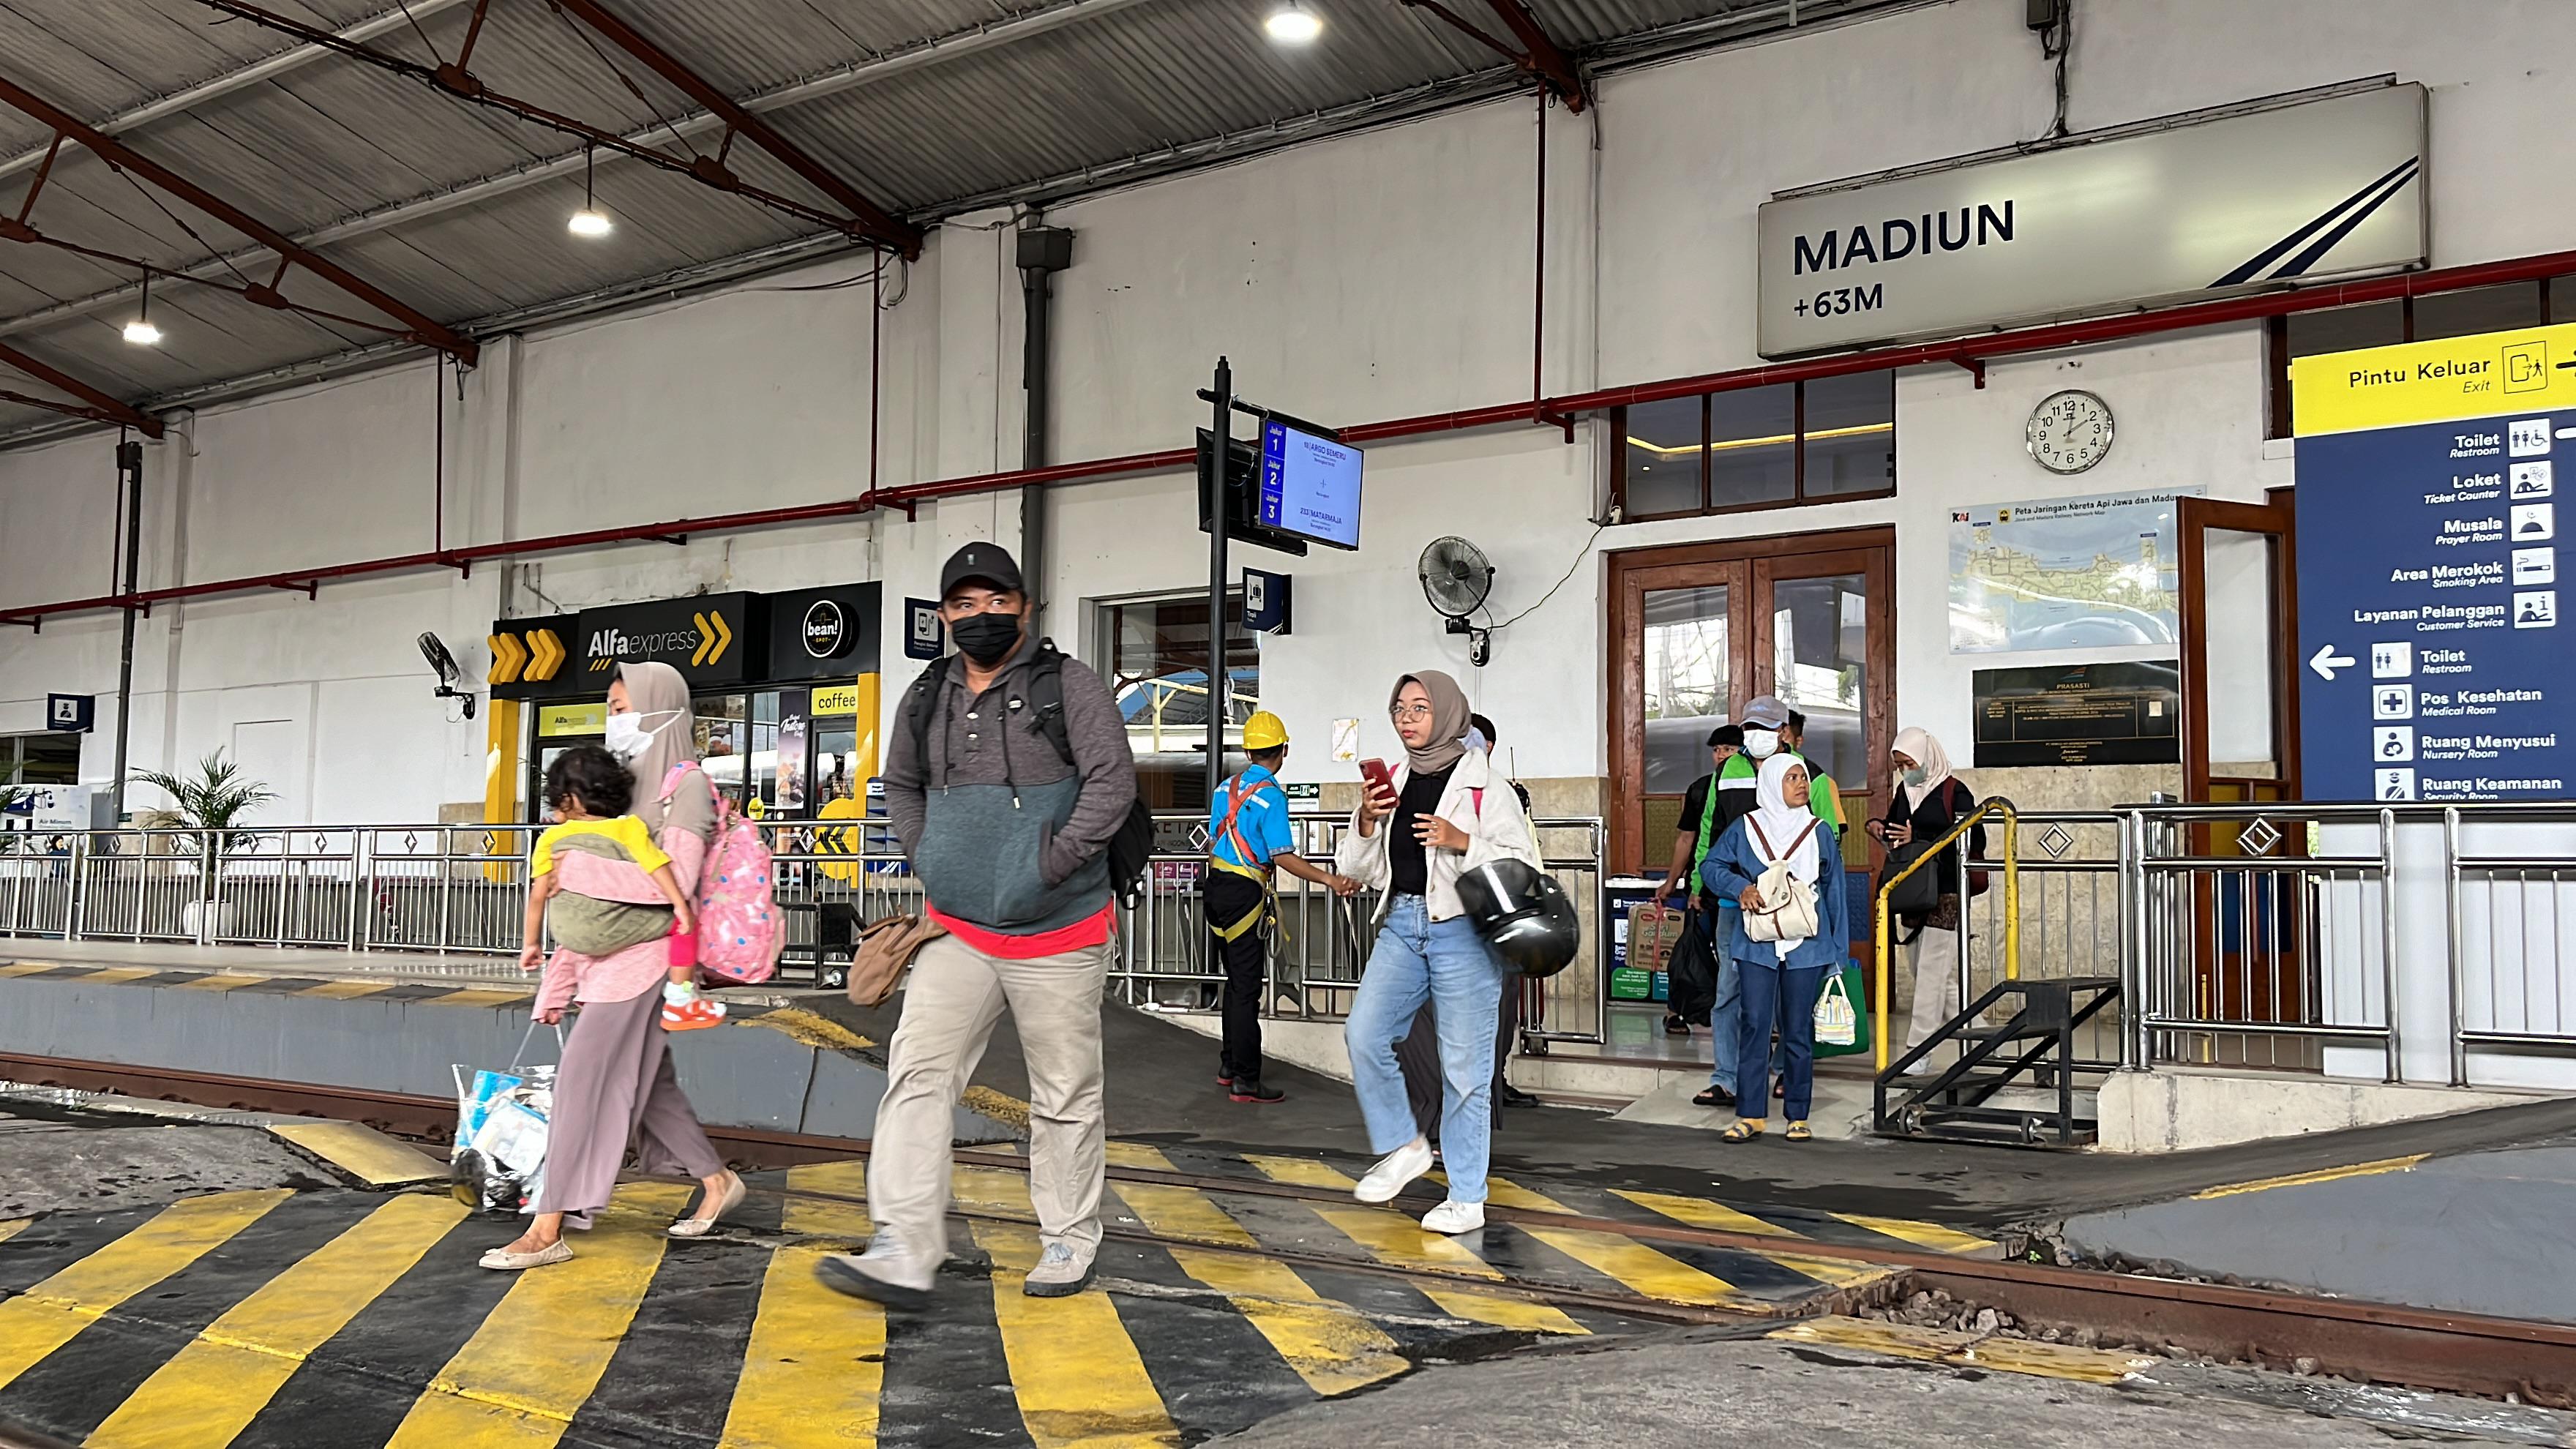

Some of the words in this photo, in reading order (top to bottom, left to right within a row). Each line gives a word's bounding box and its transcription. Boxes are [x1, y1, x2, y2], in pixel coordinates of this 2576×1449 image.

[1794, 200, 2014, 276] MADIUN
[1794, 283, 1883, 318] +63M
[2349, 369, 2406, 388] Pintu
[2417, 358, 2491, 380] Keluar
[2463, 380, 2491, 394] Exit
[2052, 406, 2060, 416] 11
[2063, 400, 2075, 411] 12
[2081, 402, 2085, 412] 1
[2042, 416, 2053, 427] 10
[2089, 411, 2097, 422] 2
[2039, 430, 2047, 441] 9
[2094, 424, 2100, 434] 3
[1273, 438, 1278, 452] 1
[2090, 438, 2097, 447] 4
[2455, 433, 2500, 449] Toilet
[1311, 443, 1325, 454] ARGO
[2043, 443, 2051, 454] 8
[2081, 448, 2088, 458] 5
[2449, 446, 2499, 459] Restroom
[2053, 452, 2060, 462] 7
[2067, 454, 2074, 464] 6
[1270, 472, 1277, 485] 2
[2453, 473, 2501, 490] Loket
[2424, 493, 2455, 505] Ticket
[2457, 489, 2500, 502] Counter
[1268, 505, 1276, 519] 3
[2015, 507, 2032, 515] Peta
[2034, 504, 2067, 515] Jaringan
[2069, 502, 2094, 510] Kereta
[2096, 500, 2110, 509] Api
[2112, 498, 2133, 506] Jawa
[2135, 496, 2149, 504] dan
[2444, 517, 2503, 533] Musala
[2435, 534, 2470, 546] Prayer
[2472, 531, 2503, 542] Room
[2391, 568, 2428, 583] Area
[2432, 561, 2503, 579] Merokok
[2432, 577, 2476, 589] Smoking
[2478, 575, 2503, 585] Area
[2354, 608, 2418, 624] Layanan
[2422, 604, 2504, 621] Pelanggan
[807, 620, 838, 636] bean!
[2416, 621, 2465, 632] Customer
[2466, 618, 2504, 629] Service
[2420, 650, 2465, 664] Toilet
[2422, 663, 2472, 674] Restroom
[819, 692, 855, 708] coffee
[2421, 692, 2449, 705] Pos
[2457, 688, 2542, 703] Kesehatan
[2422, 706, 2464, 717] Medical
[2466, 705, 2496, 716] Room
[2422, 735, 2471, 750] Ruang
[2476, 733, 2556, 750] Menyusui
[2422, 749, 2465, 761] Nursery
[2467, 749, 2498, 759] Room
[2422, 778, 2471, 793] Ruang
[2476, 777, 2562, 791] Keamanan
[2423, 792, 2465, 801] Security
[2468, 792, 2498, 801] Room
[1642, 929, 1678, 939] Gadum
[1650, 924, 1669, 932] Sri
